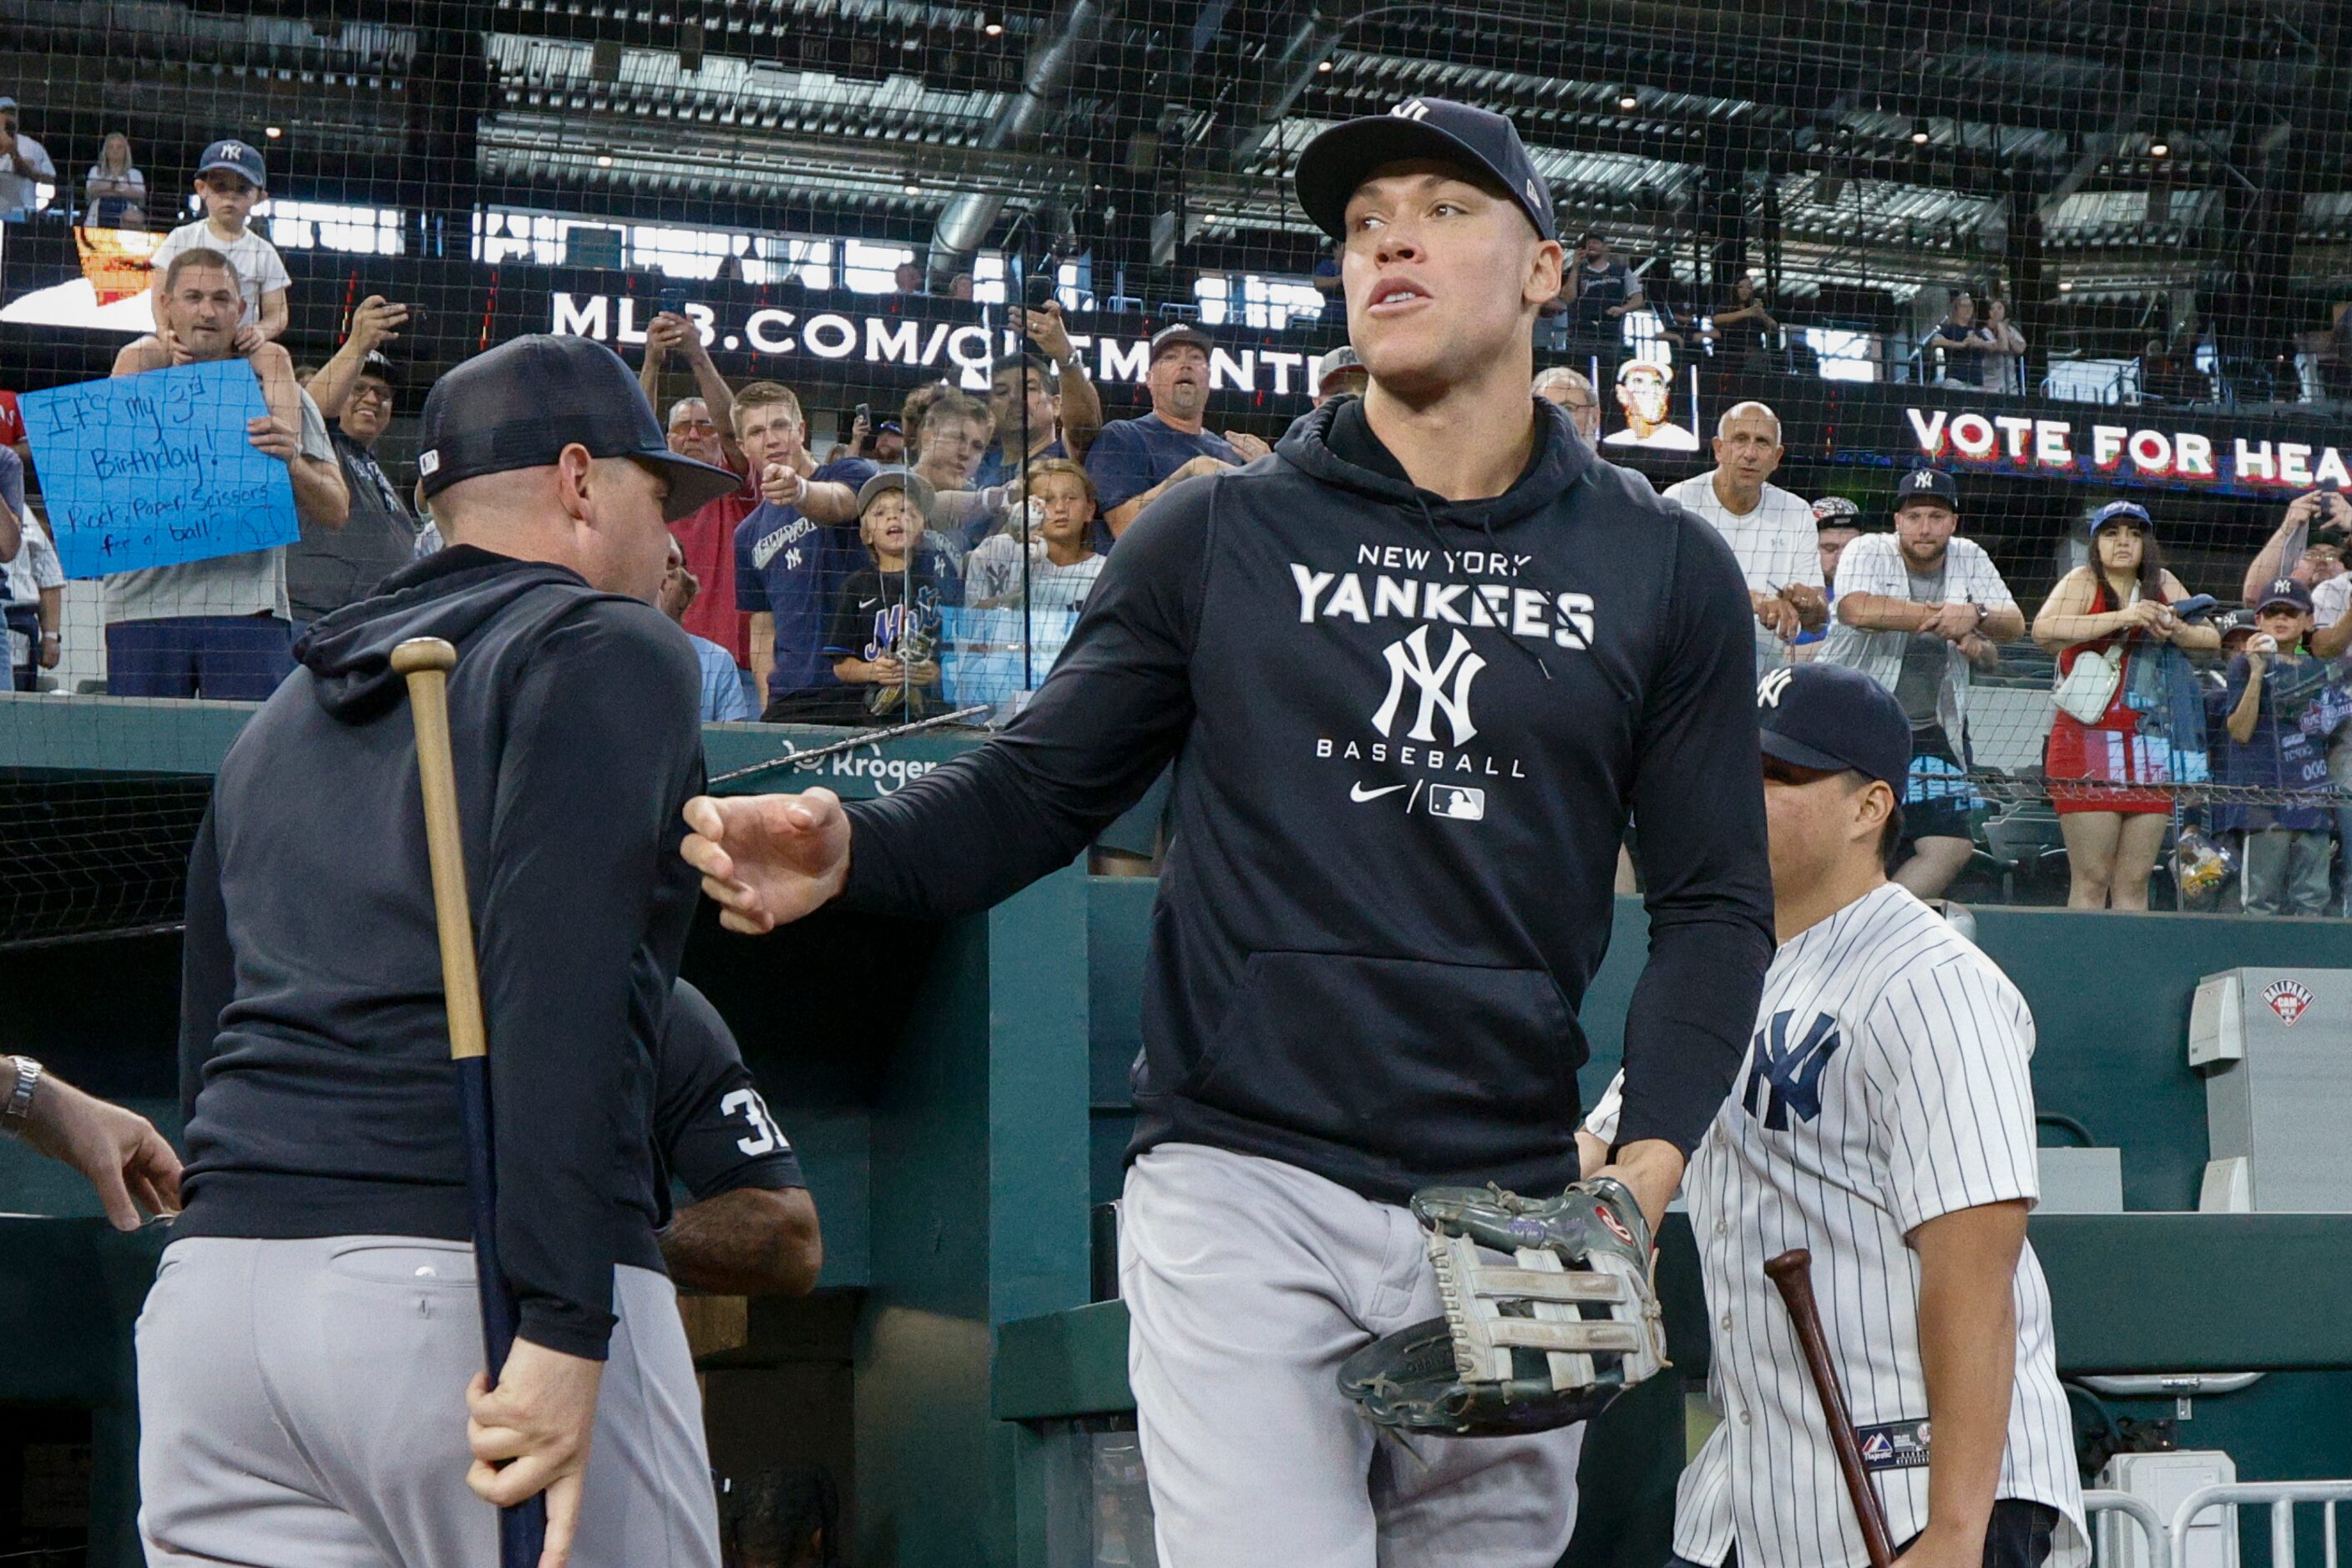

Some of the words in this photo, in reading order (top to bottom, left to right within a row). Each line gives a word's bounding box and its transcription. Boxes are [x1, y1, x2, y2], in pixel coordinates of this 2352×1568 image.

[124, 395, 163, 445] my
[169, 373, 205, 423] 3rd
[90, 423, 218, 493] Birthday!
[1906, 407, 2073, 463] VOTE
[2092, 424, 2215, 475] FOR
[190, 484, 269, 511] Scissors
[1914, 471, 1934, 488] NY
[784, 547, 802, 570] NY
[1357, 544, 1431, 571] NEW
[1443, 549, 1532, 577] YORK
[1289, 562, 1595, 650] YANKEES
[2274, 579, 2292, 594] NY
[1371, 624, 1488, 748] NY
[832, 740, 938, 796] Kroger
[1316, 738, 1526, 778] BASEBALL
[2263, 980, 2312, 1004] BALLPARK
[1743, 1008, 1841, 1132] NY
